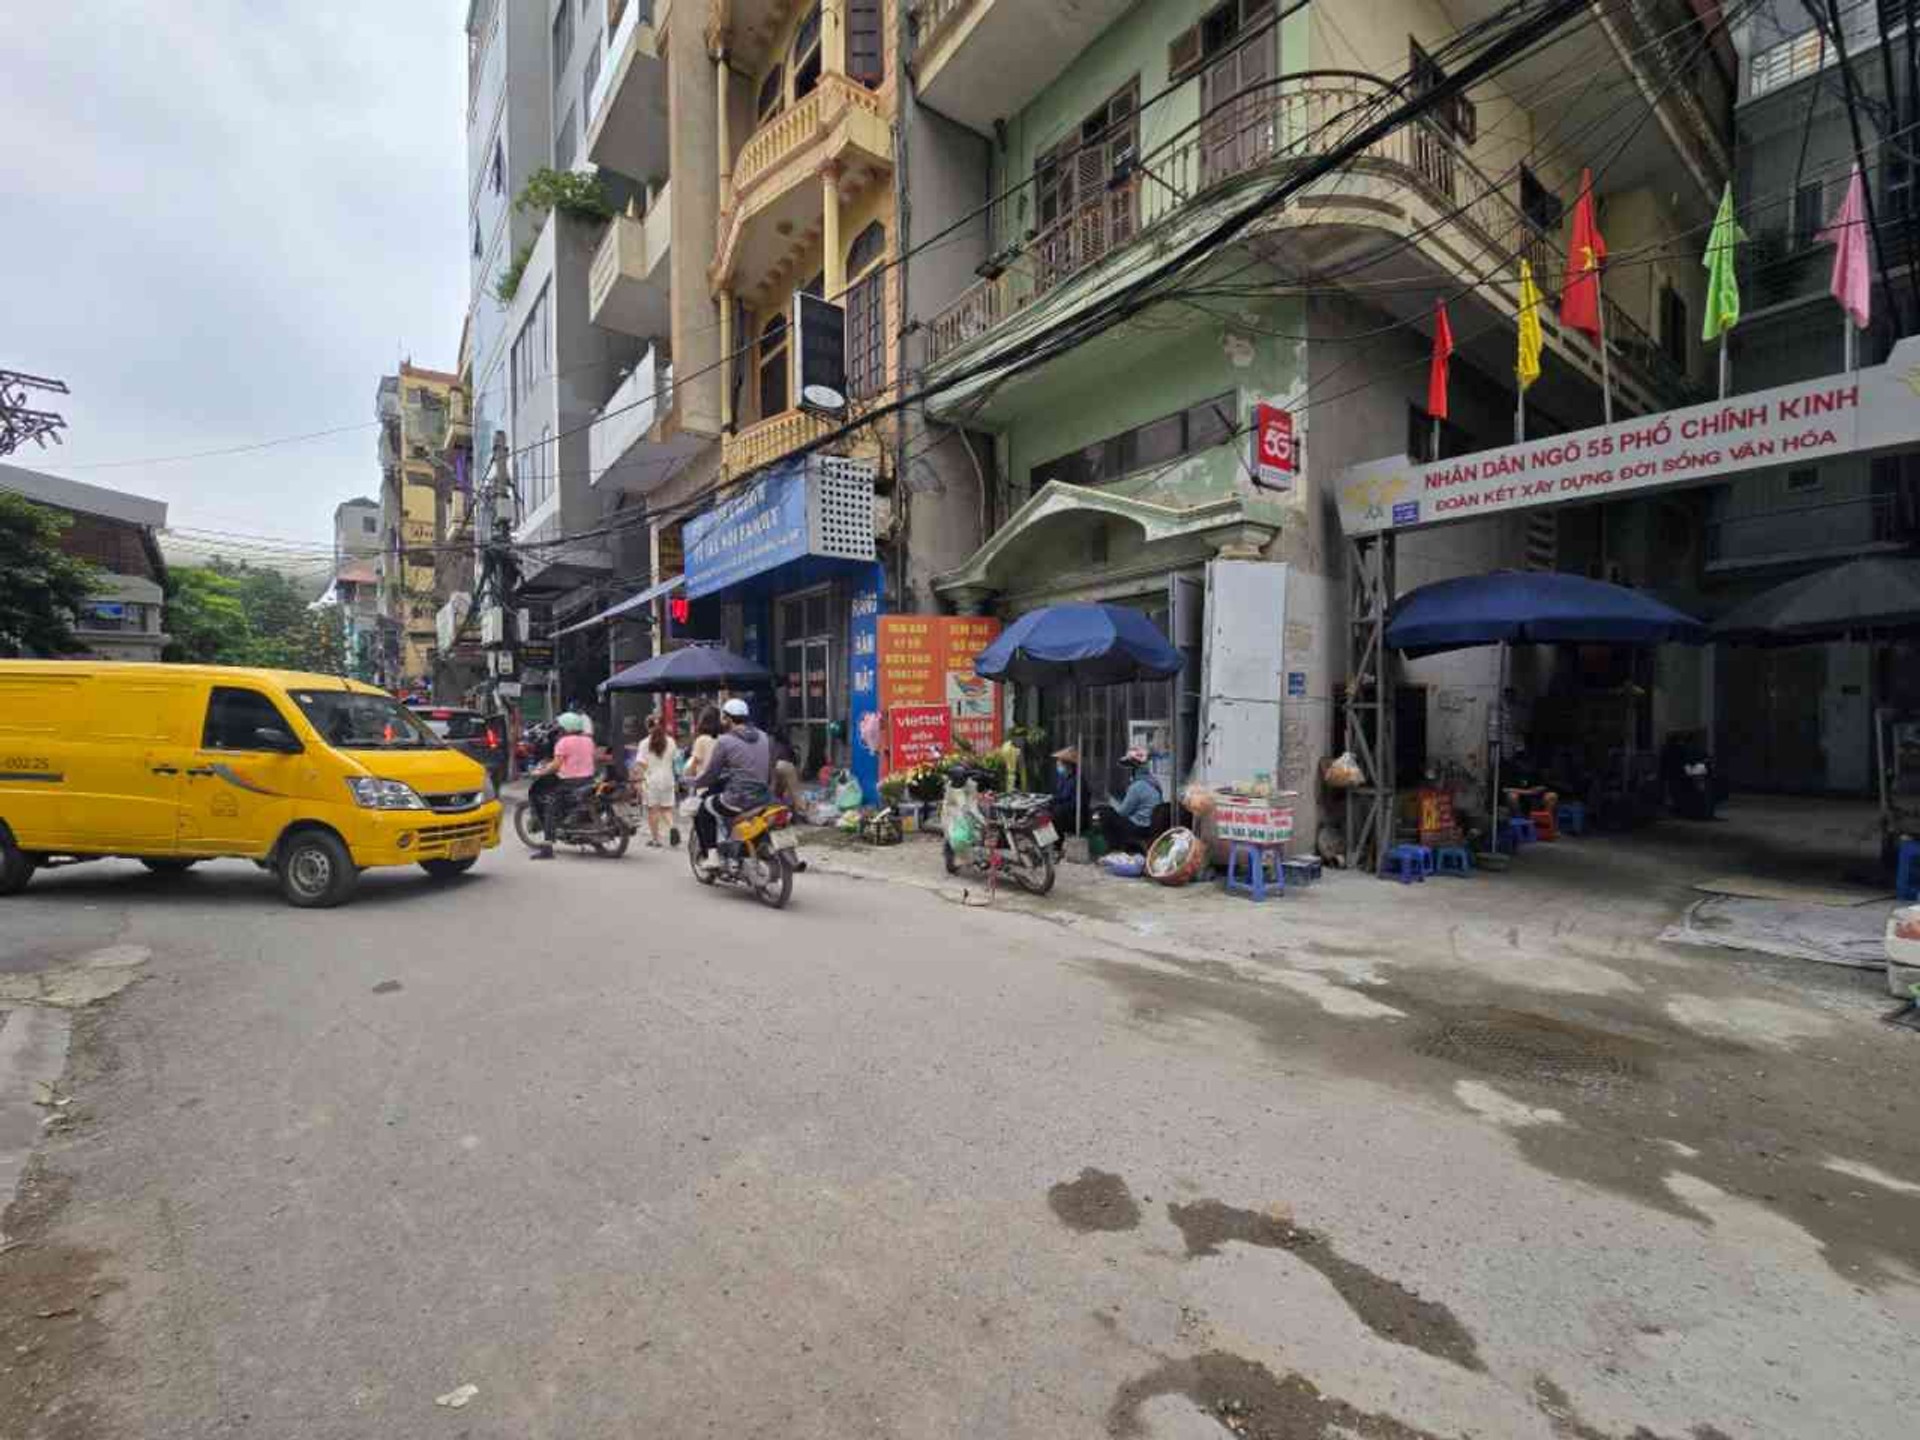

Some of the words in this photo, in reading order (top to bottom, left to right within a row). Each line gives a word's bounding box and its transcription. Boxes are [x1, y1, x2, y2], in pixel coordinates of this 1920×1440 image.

[1424, 464, 1477, 489] NHÂN
[1482, 455, 1525, 478] DÂN
[1587, 436, 1614, 458] 55
[1620, 415, 1671, 452] PHỐ
[1680, 404, 1767, 439] CHÍNH
[1779, 385, 1858, 421] KINH
[1663, 450, 1721, 471] SỐNG
[1729, 440, 1775, 460] VĂN
